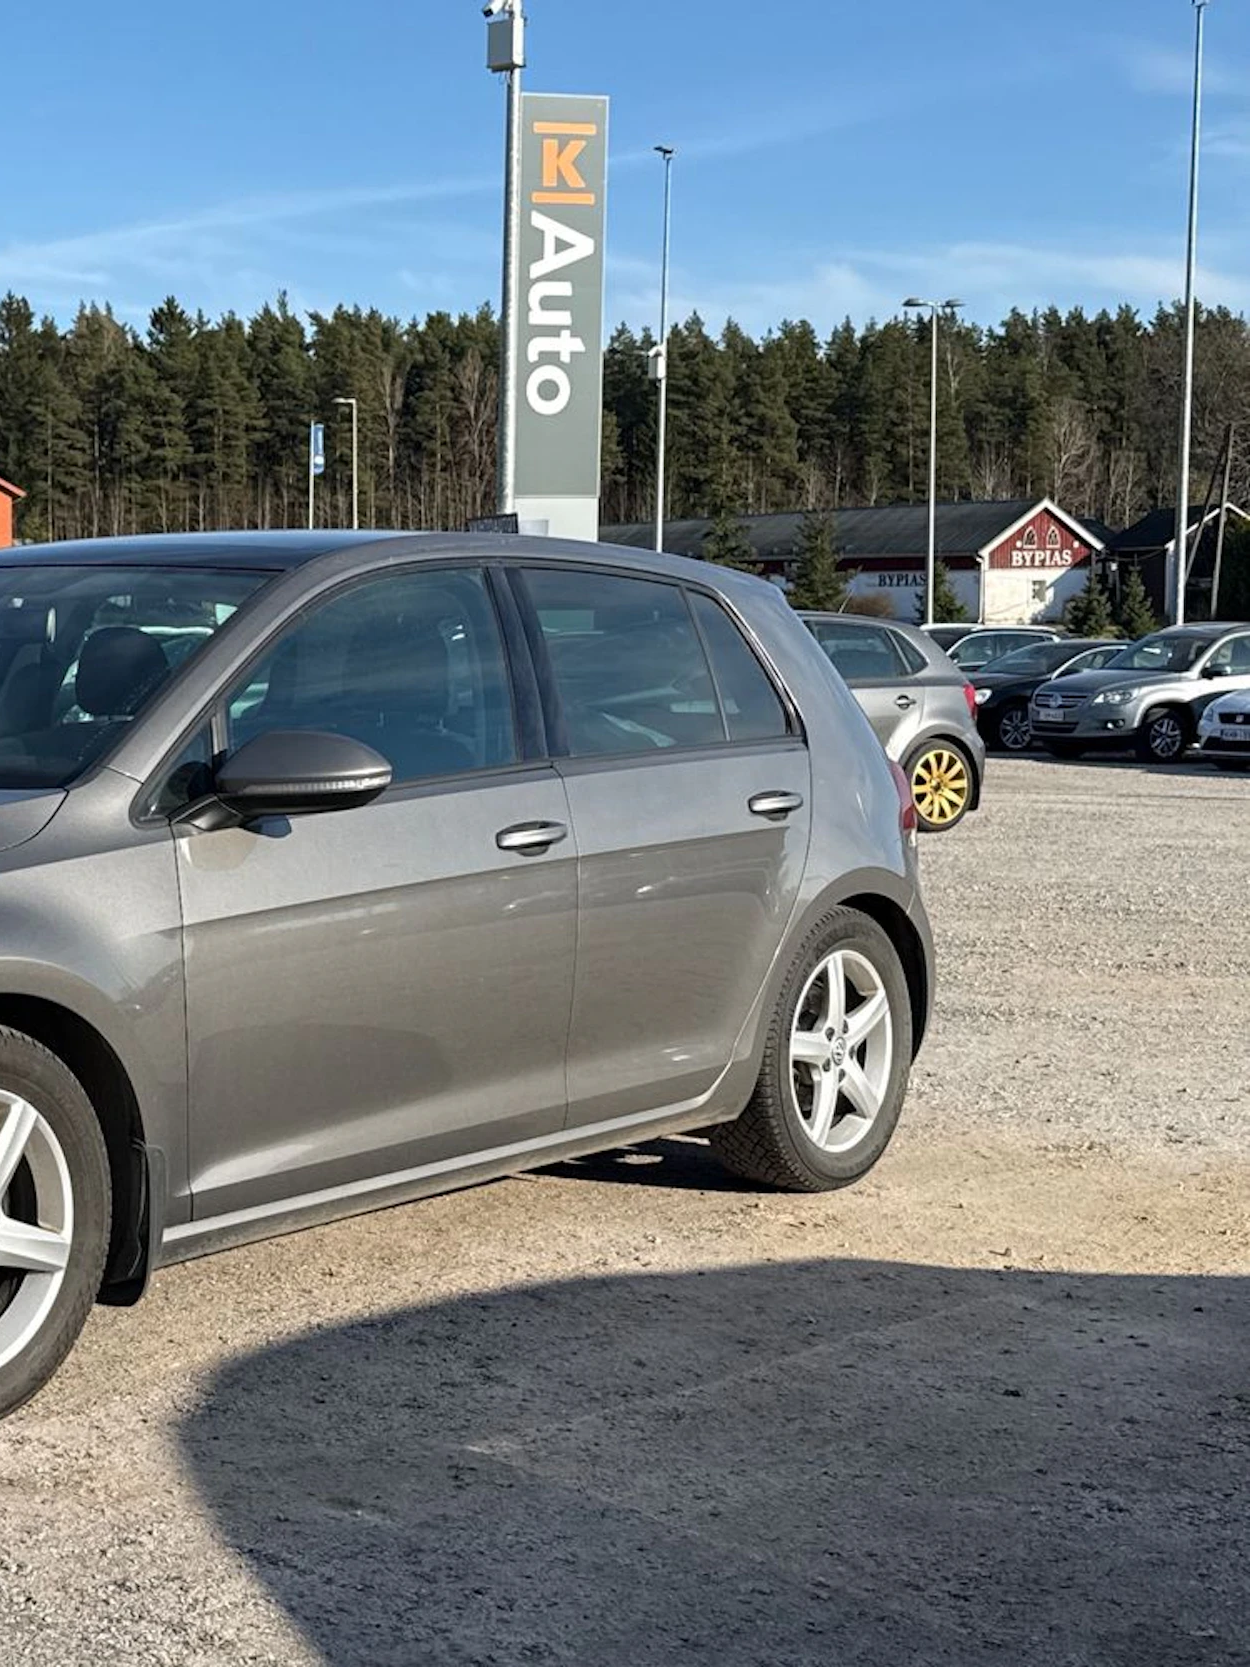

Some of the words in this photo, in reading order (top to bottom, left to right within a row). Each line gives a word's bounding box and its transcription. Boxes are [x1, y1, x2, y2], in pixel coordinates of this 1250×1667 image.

[525, 210, 595, 416] Auto
[1011, 549, 1072, 567] BYPIAS
[878, 573, 928, 588] BYPIAS
